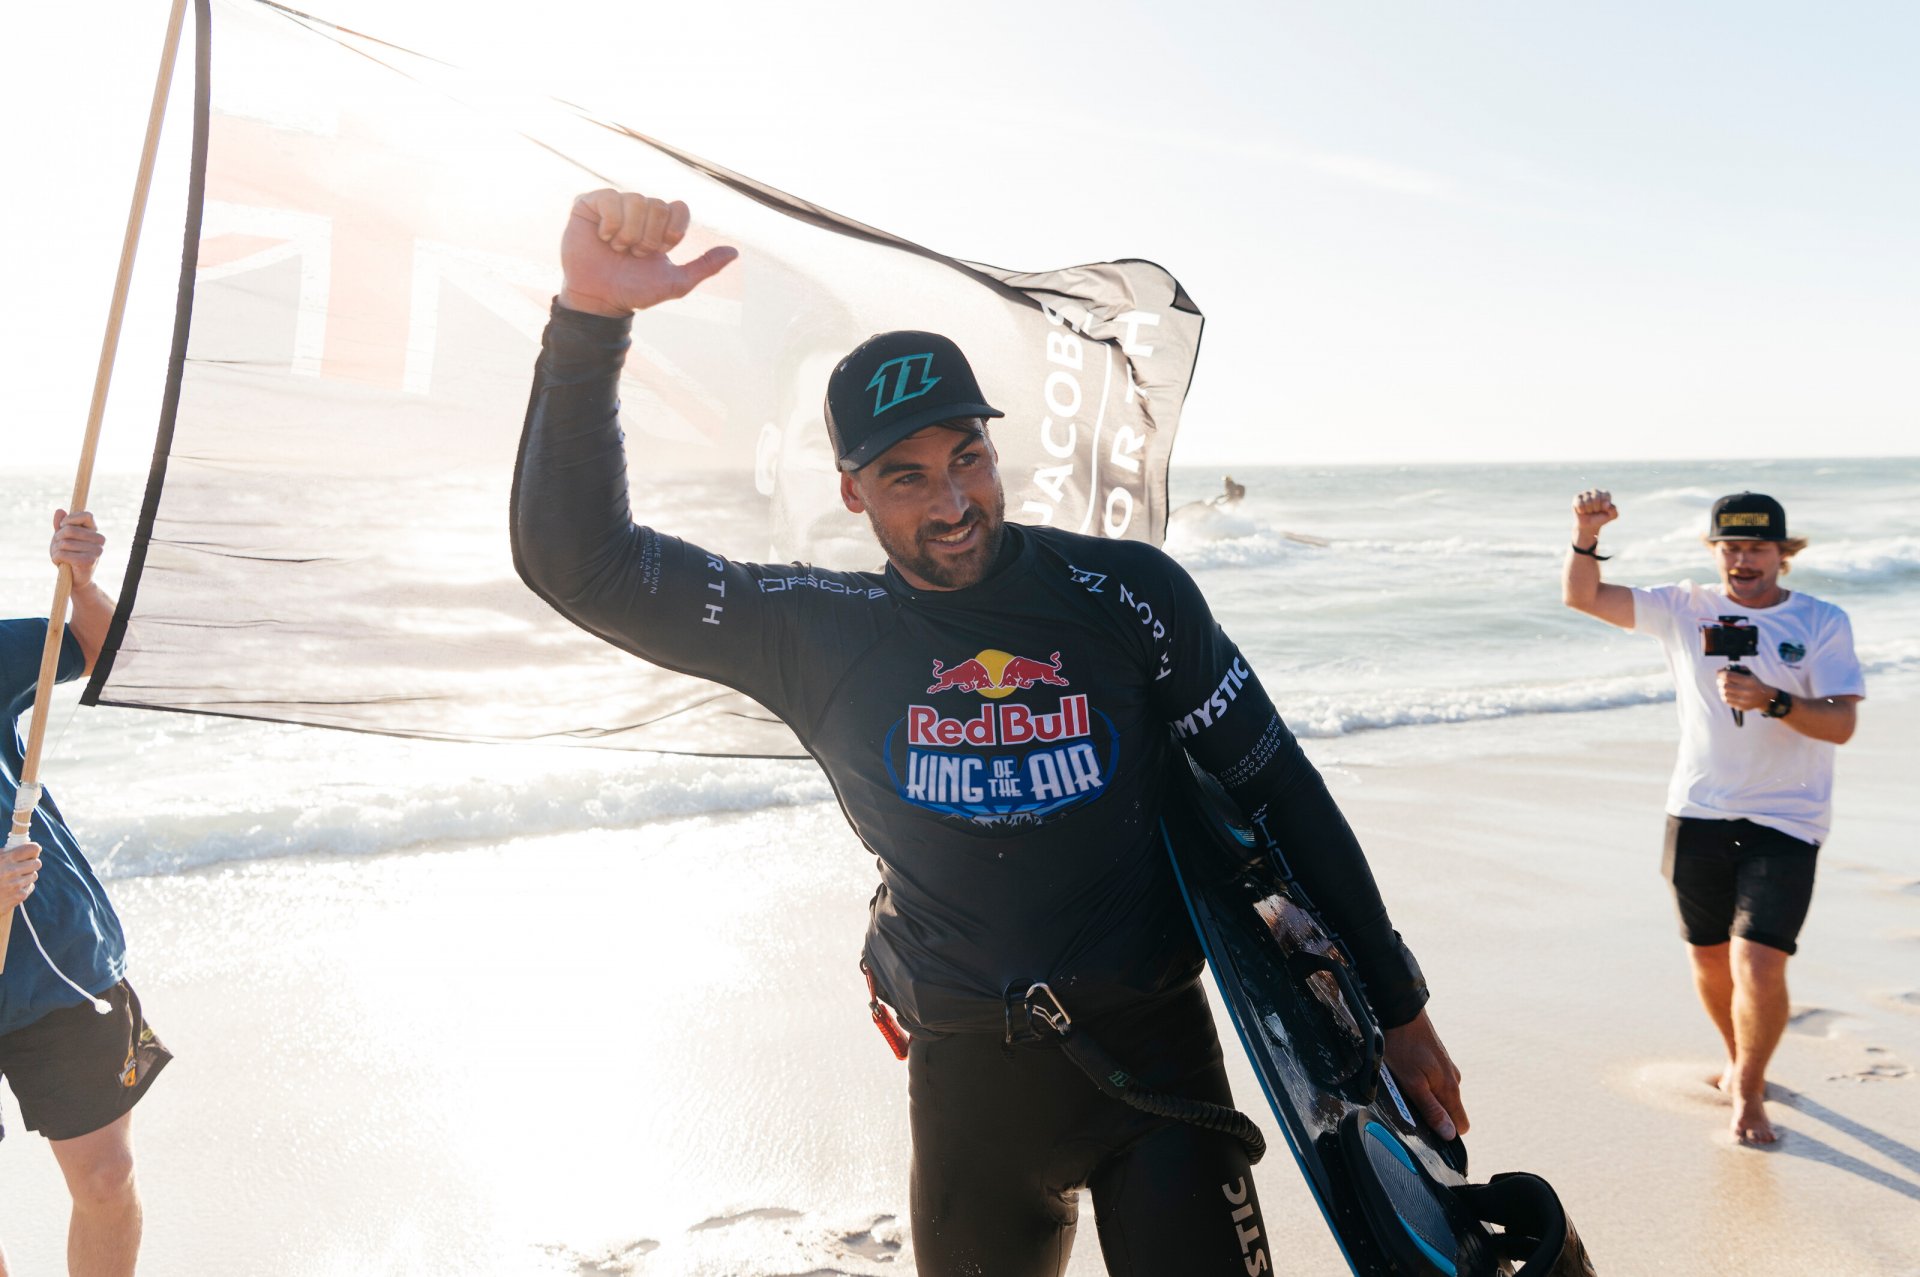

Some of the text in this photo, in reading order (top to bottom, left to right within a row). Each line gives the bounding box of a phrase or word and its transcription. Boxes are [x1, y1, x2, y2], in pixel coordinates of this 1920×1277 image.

[650, 561, 661, 594] TOWN
[908, 694, 1091, 746] Red Bull
[1175, 656, 1249, 738] MYSTIC
[906, 744, 1103, 803] KING OF THE AIR
[1240, 755, 1250, 766] OF
[1251, 733, 1268, 755] CAPE
